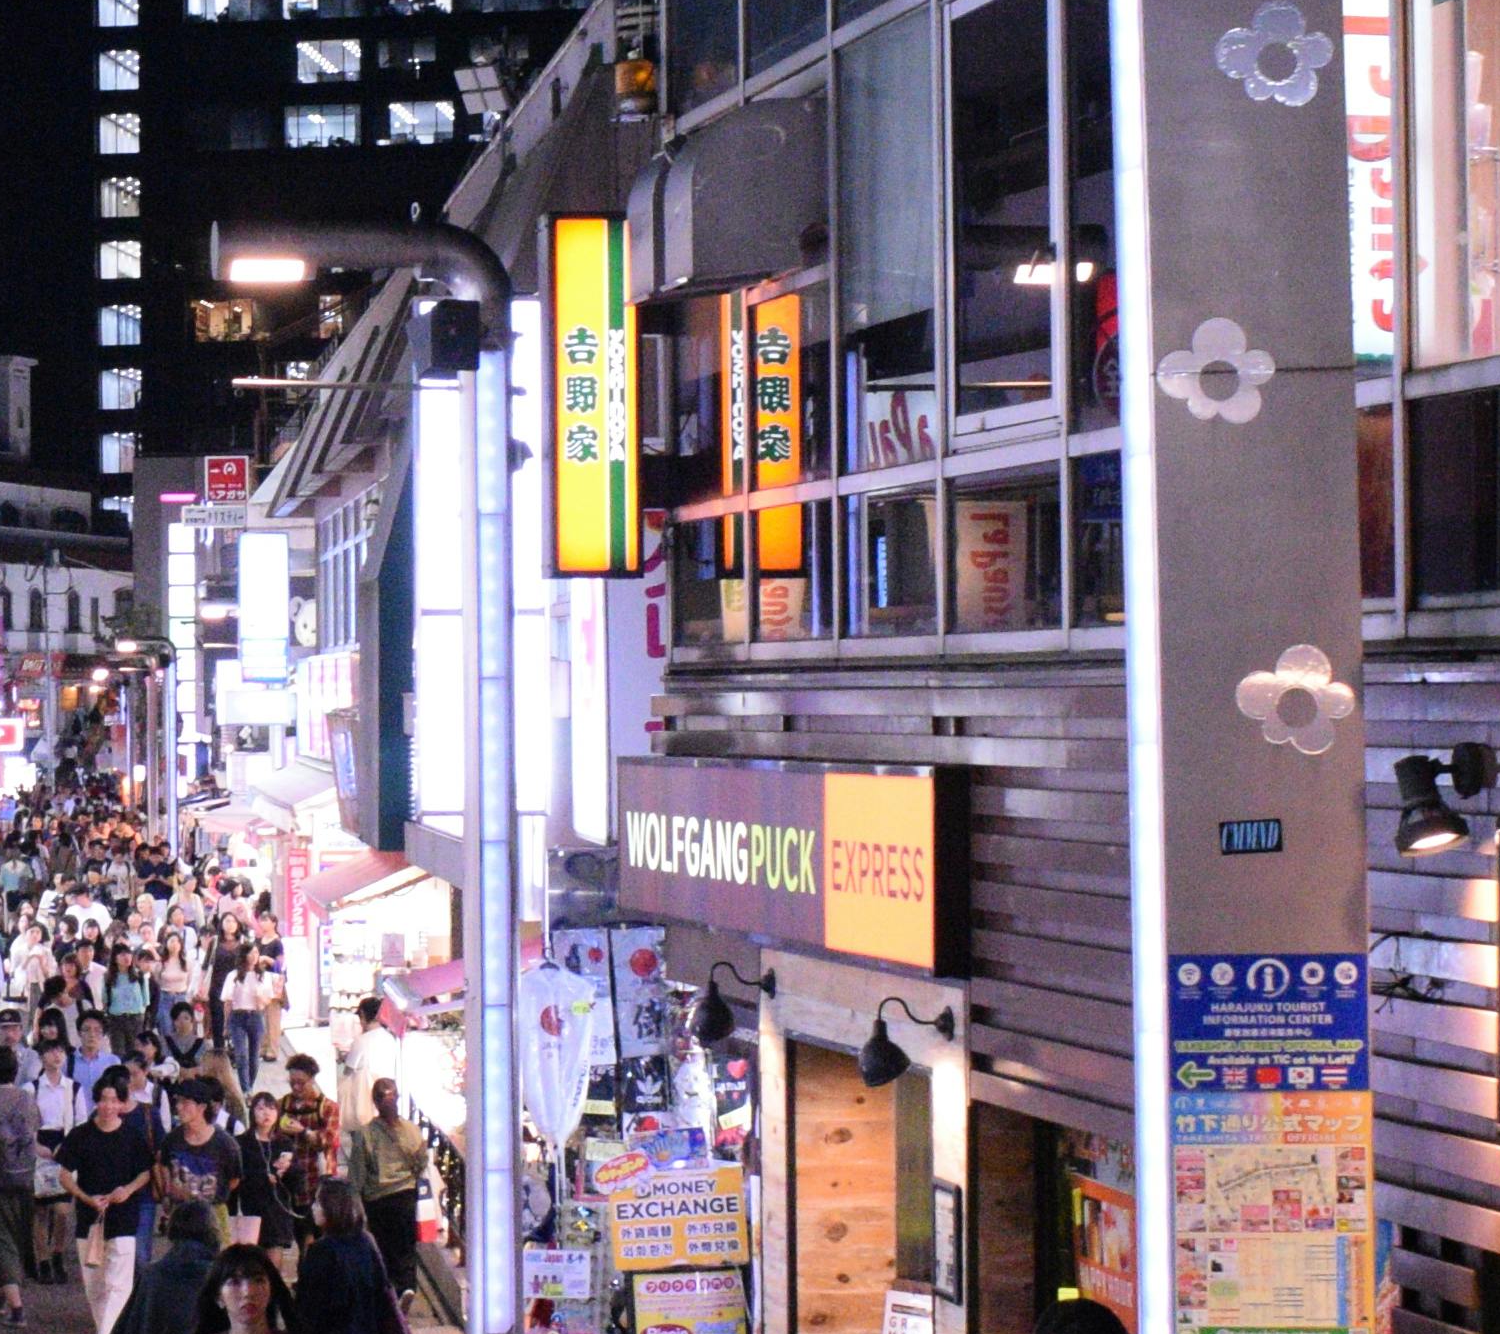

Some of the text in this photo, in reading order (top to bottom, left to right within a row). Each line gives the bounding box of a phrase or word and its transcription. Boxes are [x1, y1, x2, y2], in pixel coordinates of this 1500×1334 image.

[564, 326, 599, 464] 吉野家
[627, 810, 926, 904] WOLFGANG PUCK EXPRESS
[1210, 1001, 1326, 1014] HARAJUKU TOURIST
[1288, 1013, 1333, 1025] CENTER
[1272, 1054, 1291, 1065] TIC
[1175, 1113, 1365, 1133] 竹下通り公式マップ
[652, 1179, 716, 1196] MONEY
[616, 1196, 739, 1221] EXCHANGE
